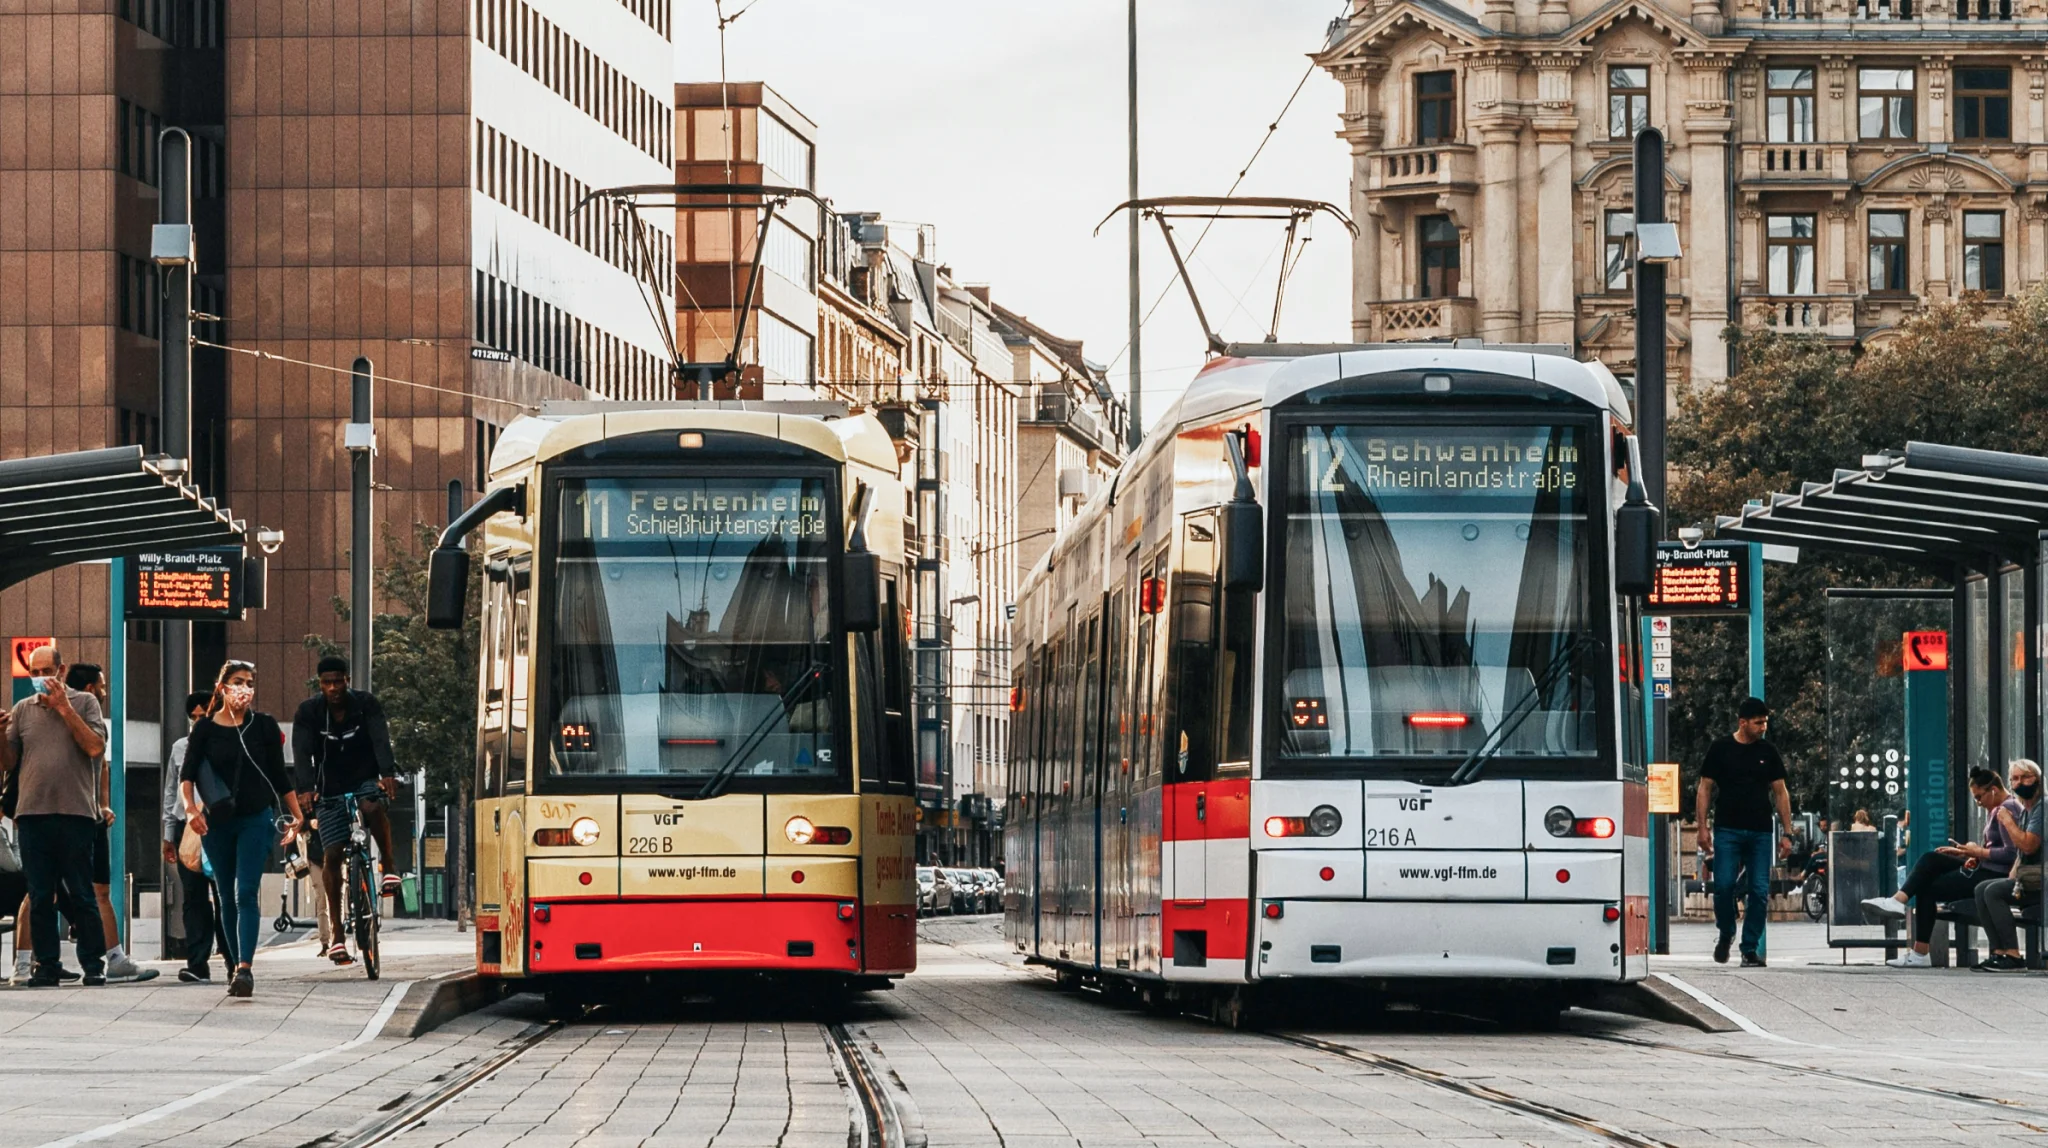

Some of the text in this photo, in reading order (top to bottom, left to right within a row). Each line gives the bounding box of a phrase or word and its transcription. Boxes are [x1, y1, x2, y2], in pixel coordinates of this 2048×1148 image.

[472, 349, 509, 361] 4112W12
[1302, 439, 1579, 492] 12 Schwanheim
[1367, 464, 1577, 492] Rheinlandstraße
[576, 490, 819, 539] 11 Fechenheim
[627, 514, 825, 538] Schießhüttenstraße
[139, 553, 222, 565] Willy-Brandt-Platz
[1656, 549, 1729, 561] illy-Brandt-Platz
[139, 572, 148, 580] 11
[139, 581, 148, 589] 14
[1655, 642, 1664, 651] 11
[1923, 635, 1944, 645] SOS
[1655, 663, 1665, 672] 12
[1399, 789, 1433, 811] VGF
[654, 805, 684, 825] VGF
[1367, 827, 1417, 846] 216 A
[629, 836, 674, 854] 226 B
[648, 866, 736, 880] www.vgf-ffm.de
[1399, 865, 1498, 882] www.vgf-ffm.de
